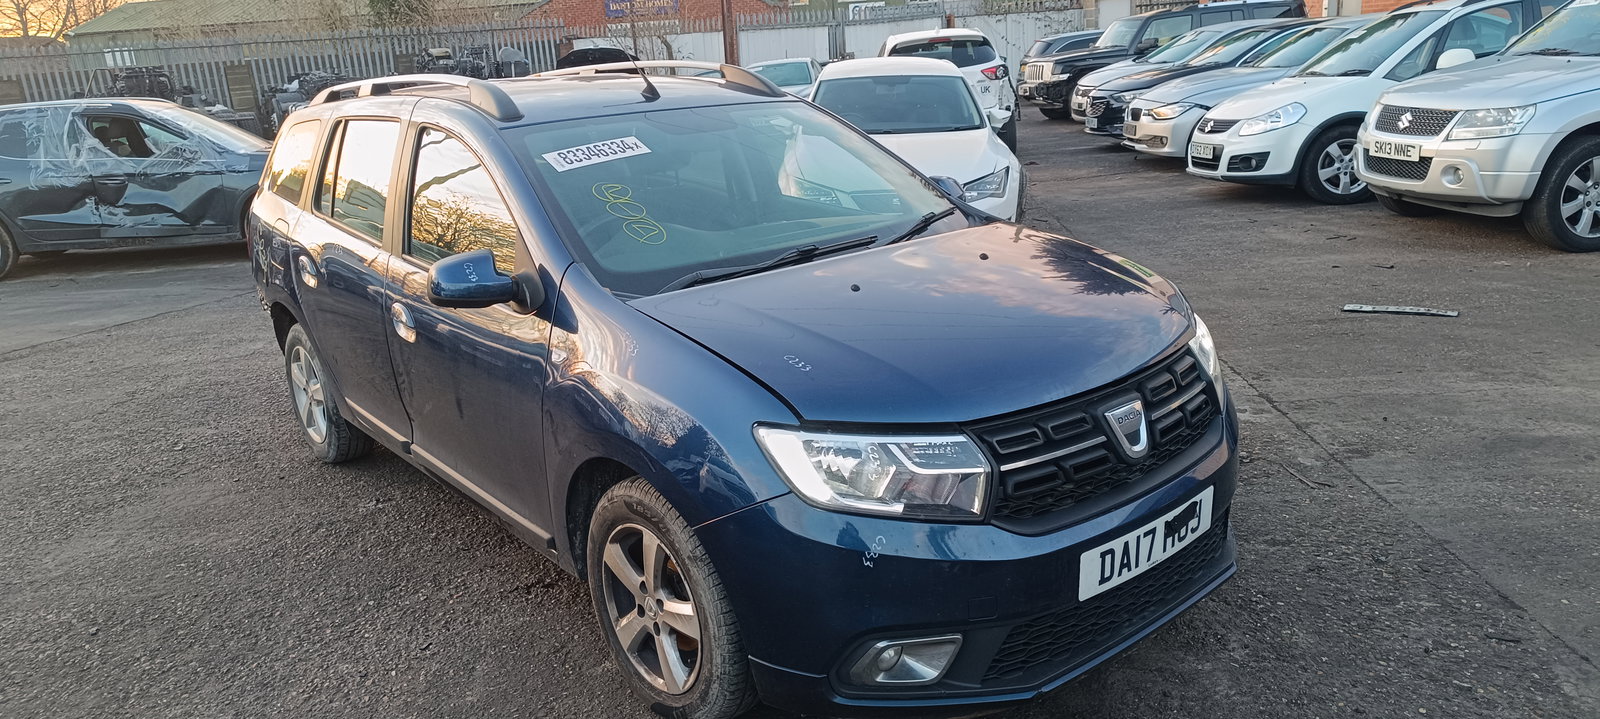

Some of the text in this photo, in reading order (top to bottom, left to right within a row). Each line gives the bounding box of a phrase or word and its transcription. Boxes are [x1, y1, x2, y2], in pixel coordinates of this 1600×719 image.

[980, 85, 991, 94] UK
[1374, 141, 1412, 158] SK13 NNE
[783, 354, 813, 373] C233
[1116, 408, 1143, 426] DACIA
[867, 446, 881, 481] C233
[862, 535, 887, 568] C233
[1097, 526, 1158, 587] DA17
